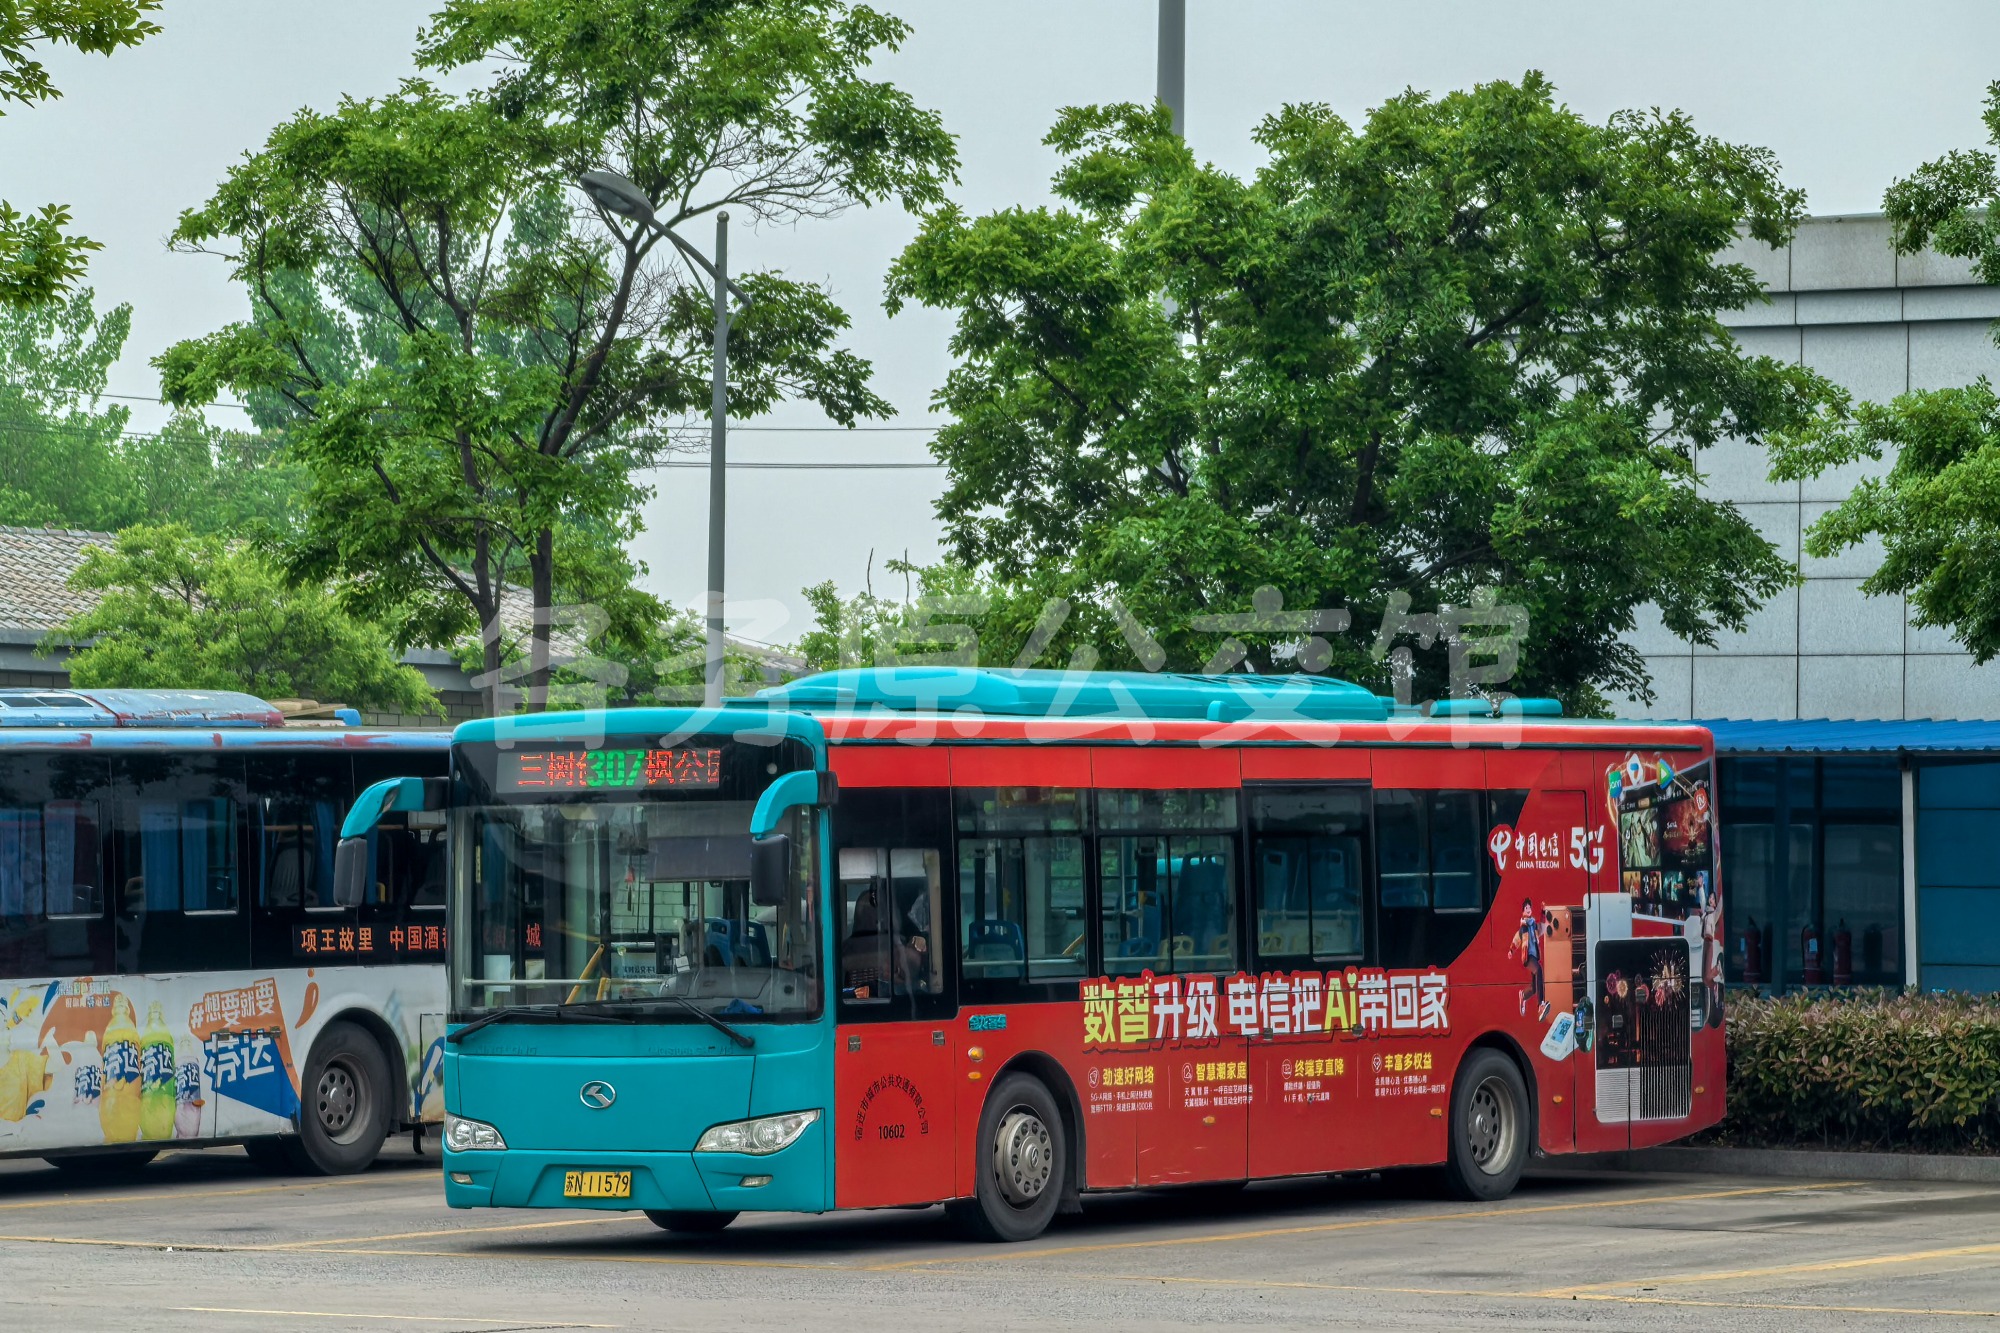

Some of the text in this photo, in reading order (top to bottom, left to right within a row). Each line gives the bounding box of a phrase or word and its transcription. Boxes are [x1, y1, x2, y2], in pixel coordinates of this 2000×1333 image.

[586, 750, 645, 787] 307
[1515, 825, 1604, 874] 中国电信 5G
[1516, 861, 1559, 869] CHINA TELECOM
[301, 928, 373, 952] 项王故里
[191, 980, 275, 1028] #想要就要
[1084, 972, 1448, 1043] 数智升级 电信把Ai带回家
[104, 1041, 139, 1082] 芬达
[140, 1043, 173, 1083] 芬达
[205, 1028, 275, 1089] 芬达
[1196, 1061, 1246, 1081] 智慧潮家庭
[1294, 1058, 1344, 1077] 终端享直降
[1385, 1052, 1432, 1071] 丰富多权益
[75, 1066, 101, 1098] 芬达
[175, 1064, 199, 1096] 芬达
[1103, 1066, 1154, 1085] 劲速好网络
[879, 1124, 905, 1140] 10602
